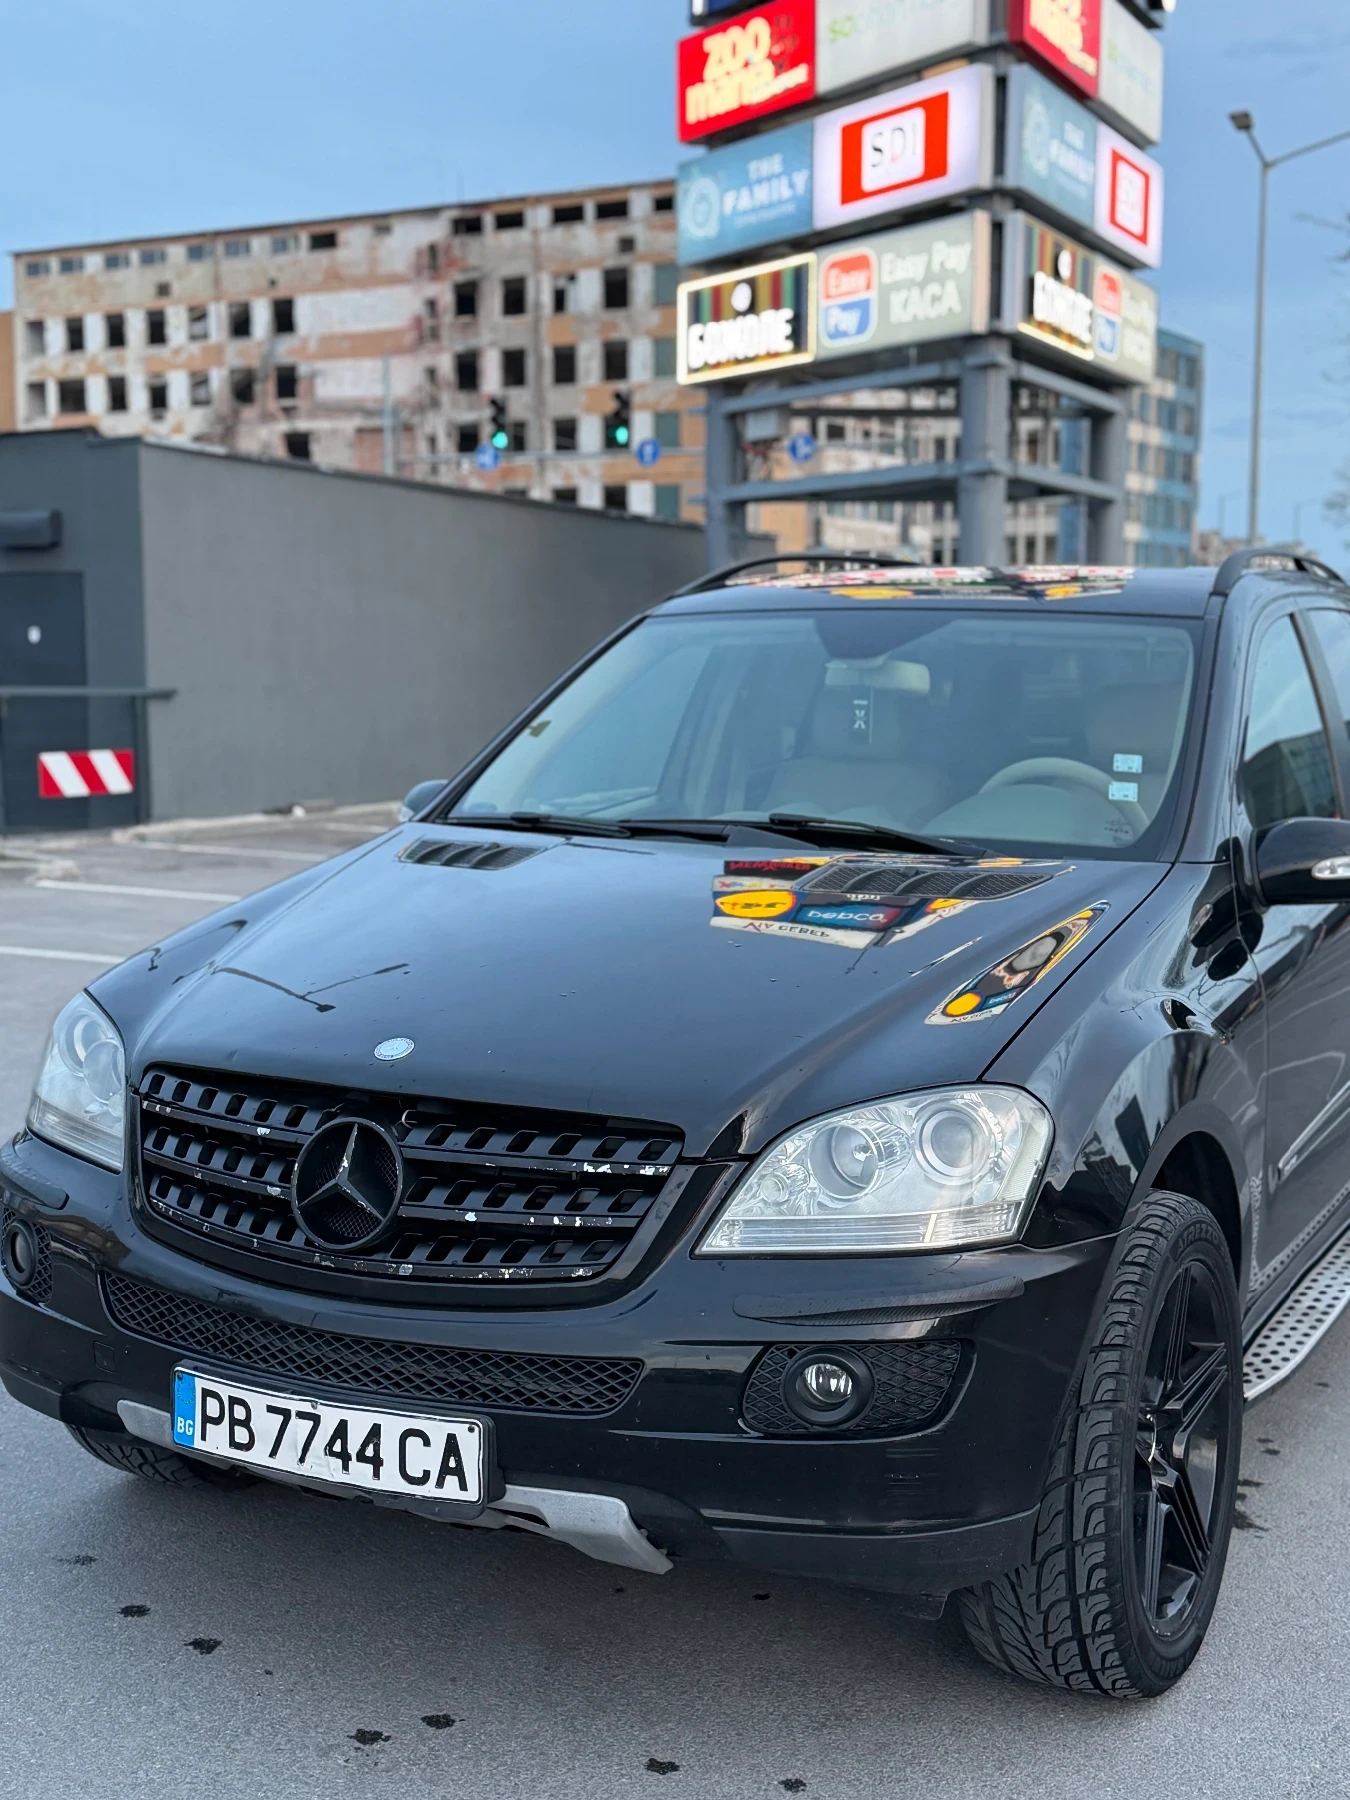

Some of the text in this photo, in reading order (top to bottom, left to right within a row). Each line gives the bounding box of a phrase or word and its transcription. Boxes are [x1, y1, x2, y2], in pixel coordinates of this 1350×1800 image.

[870, 122, 917, 168] SDI
[747, 152, 783, 183] THE
[722, 168, 809, 216] FAMILY
[828, 267, 869, 293] Easy
[881, 241, 971, 285] Easy Pay
[827, 306, 861, 335] Pay
[176, 1417, 194, 1436] BG
[200, 1387, 468, 1492] PB 7744 CA
